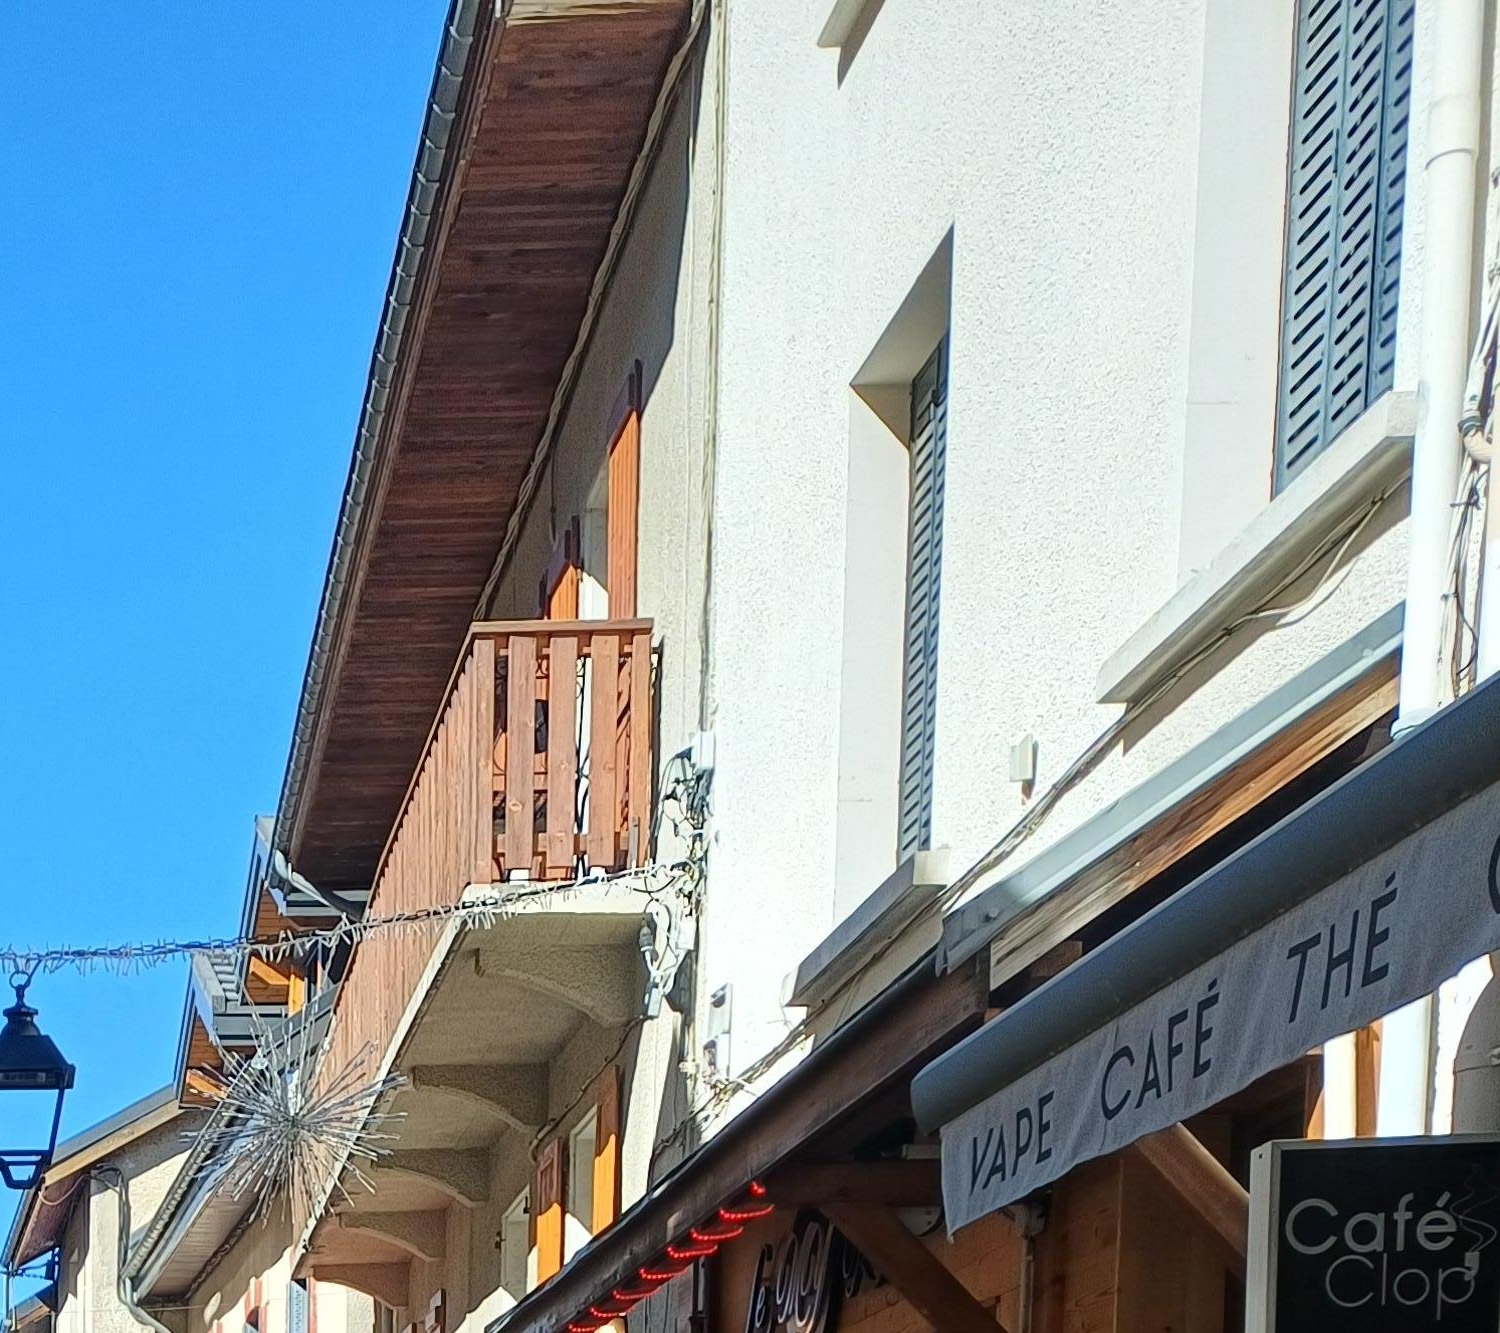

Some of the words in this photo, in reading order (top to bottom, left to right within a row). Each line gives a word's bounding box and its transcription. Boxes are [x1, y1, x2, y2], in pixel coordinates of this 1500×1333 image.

[971, 1091, 1054, 1196] VAPE
[1101, 978, 1220, 1122] CAFÉ
[1287, 872, 1397, 1024] THÉ
[1284, 1190, 1458, 1256] Café
